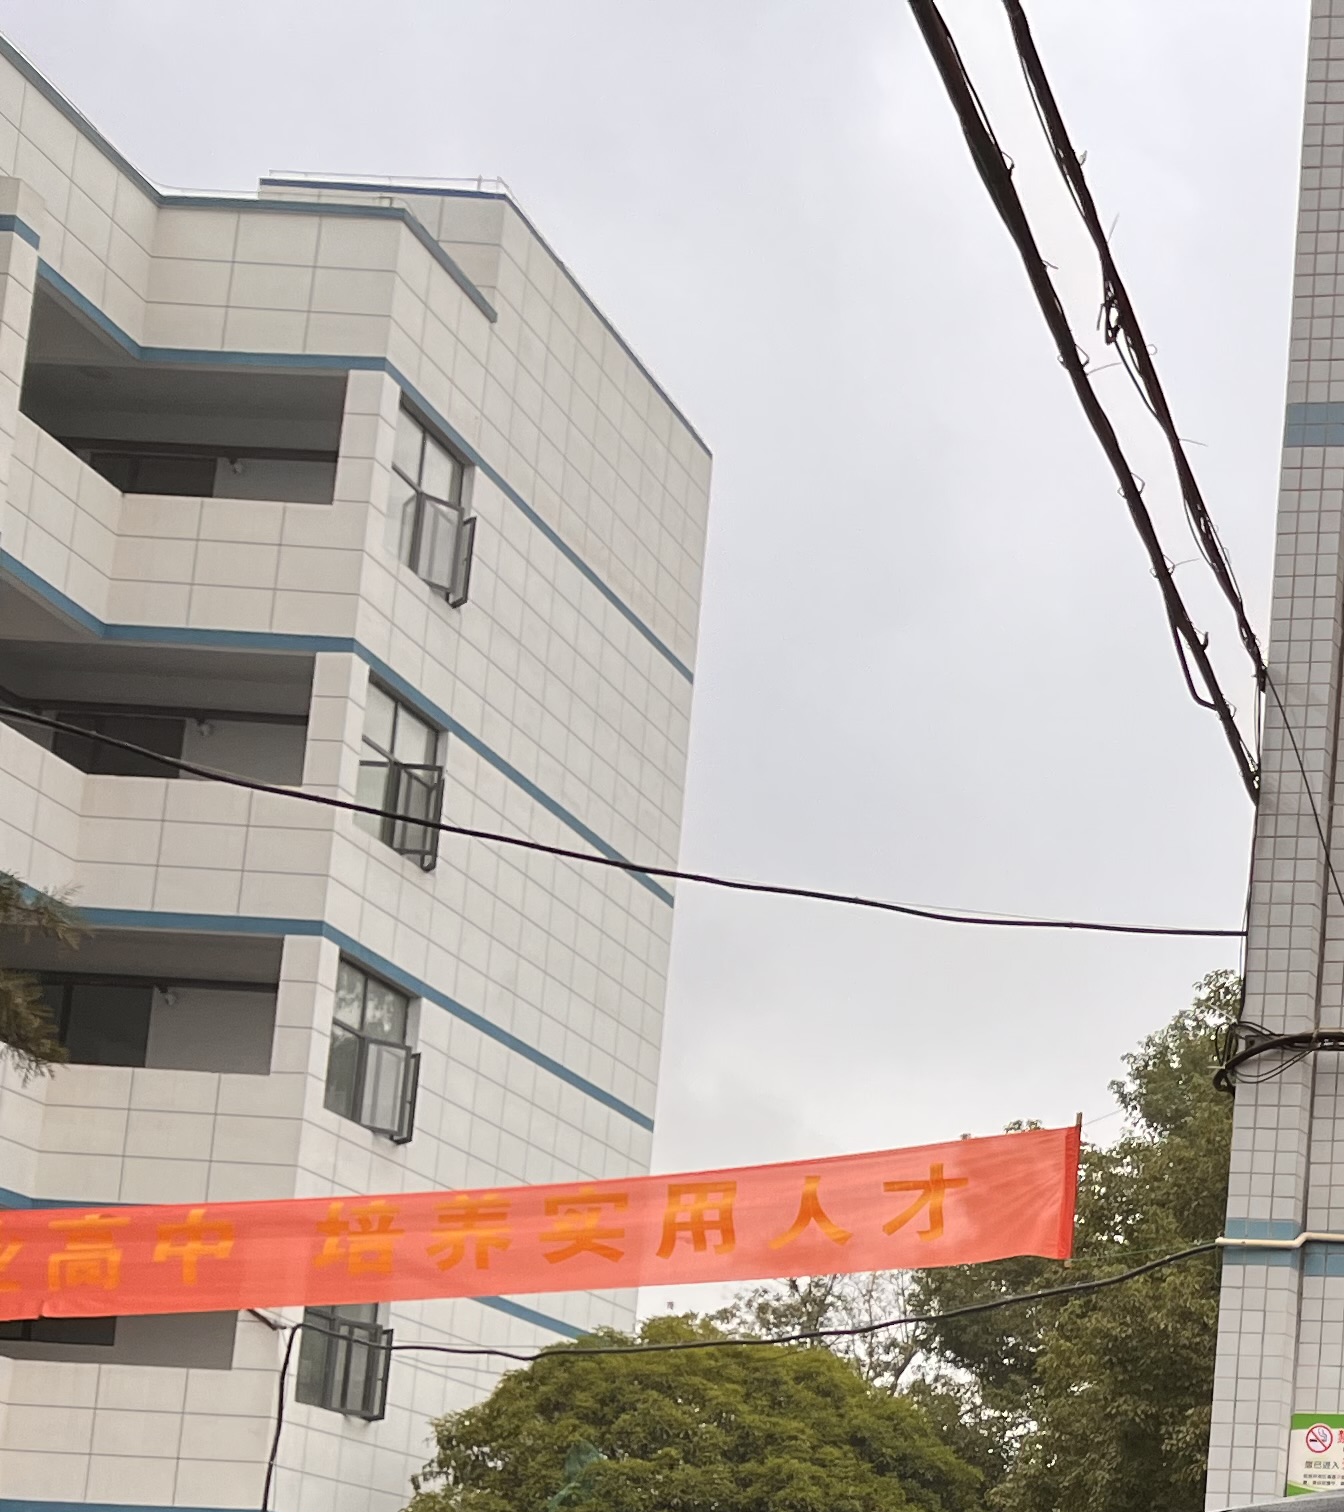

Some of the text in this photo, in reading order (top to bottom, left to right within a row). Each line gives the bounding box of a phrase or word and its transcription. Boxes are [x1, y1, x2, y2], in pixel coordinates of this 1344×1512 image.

[0, 1163, 968, 1292] 高中 培养实用人才
